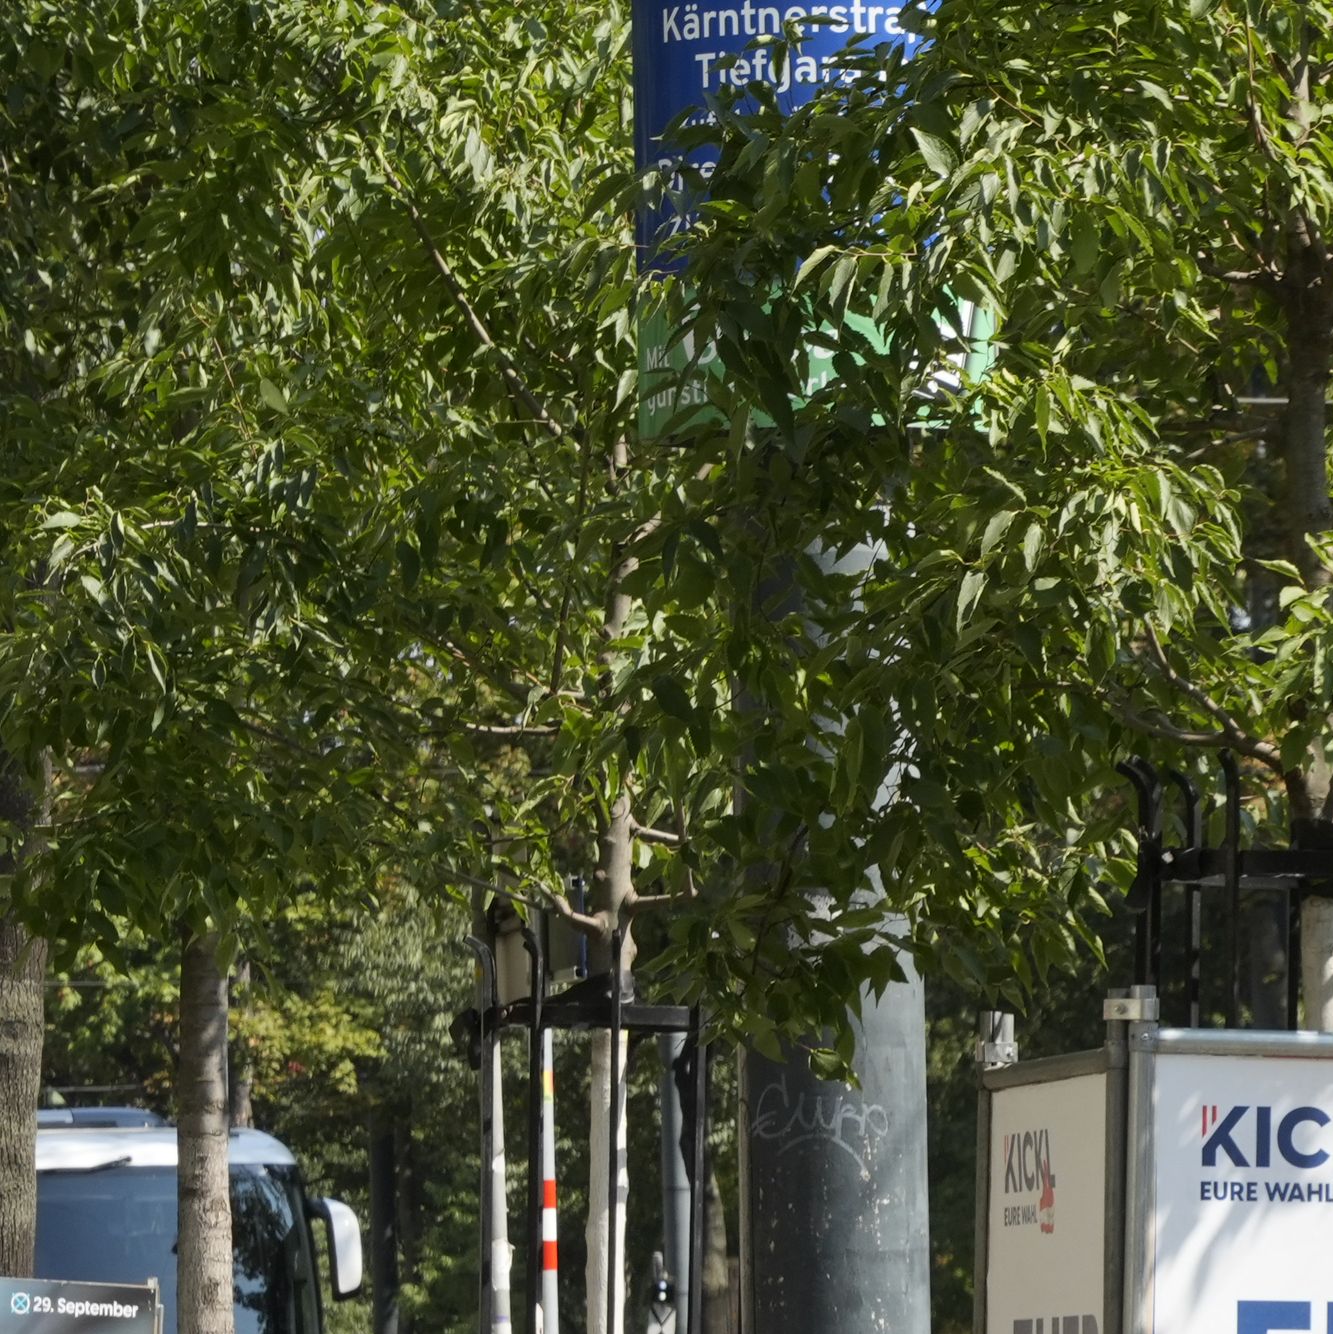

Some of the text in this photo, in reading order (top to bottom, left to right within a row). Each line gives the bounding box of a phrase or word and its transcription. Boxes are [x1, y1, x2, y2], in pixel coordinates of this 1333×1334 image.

[1004, 1129, 1056, 1194] KICKL
[1200, 1181, 1258, 1202] EURE
[1004, 1204, 1038, 1227] EURE WAHL
[33, 1296, 139, 1319] 29. September
